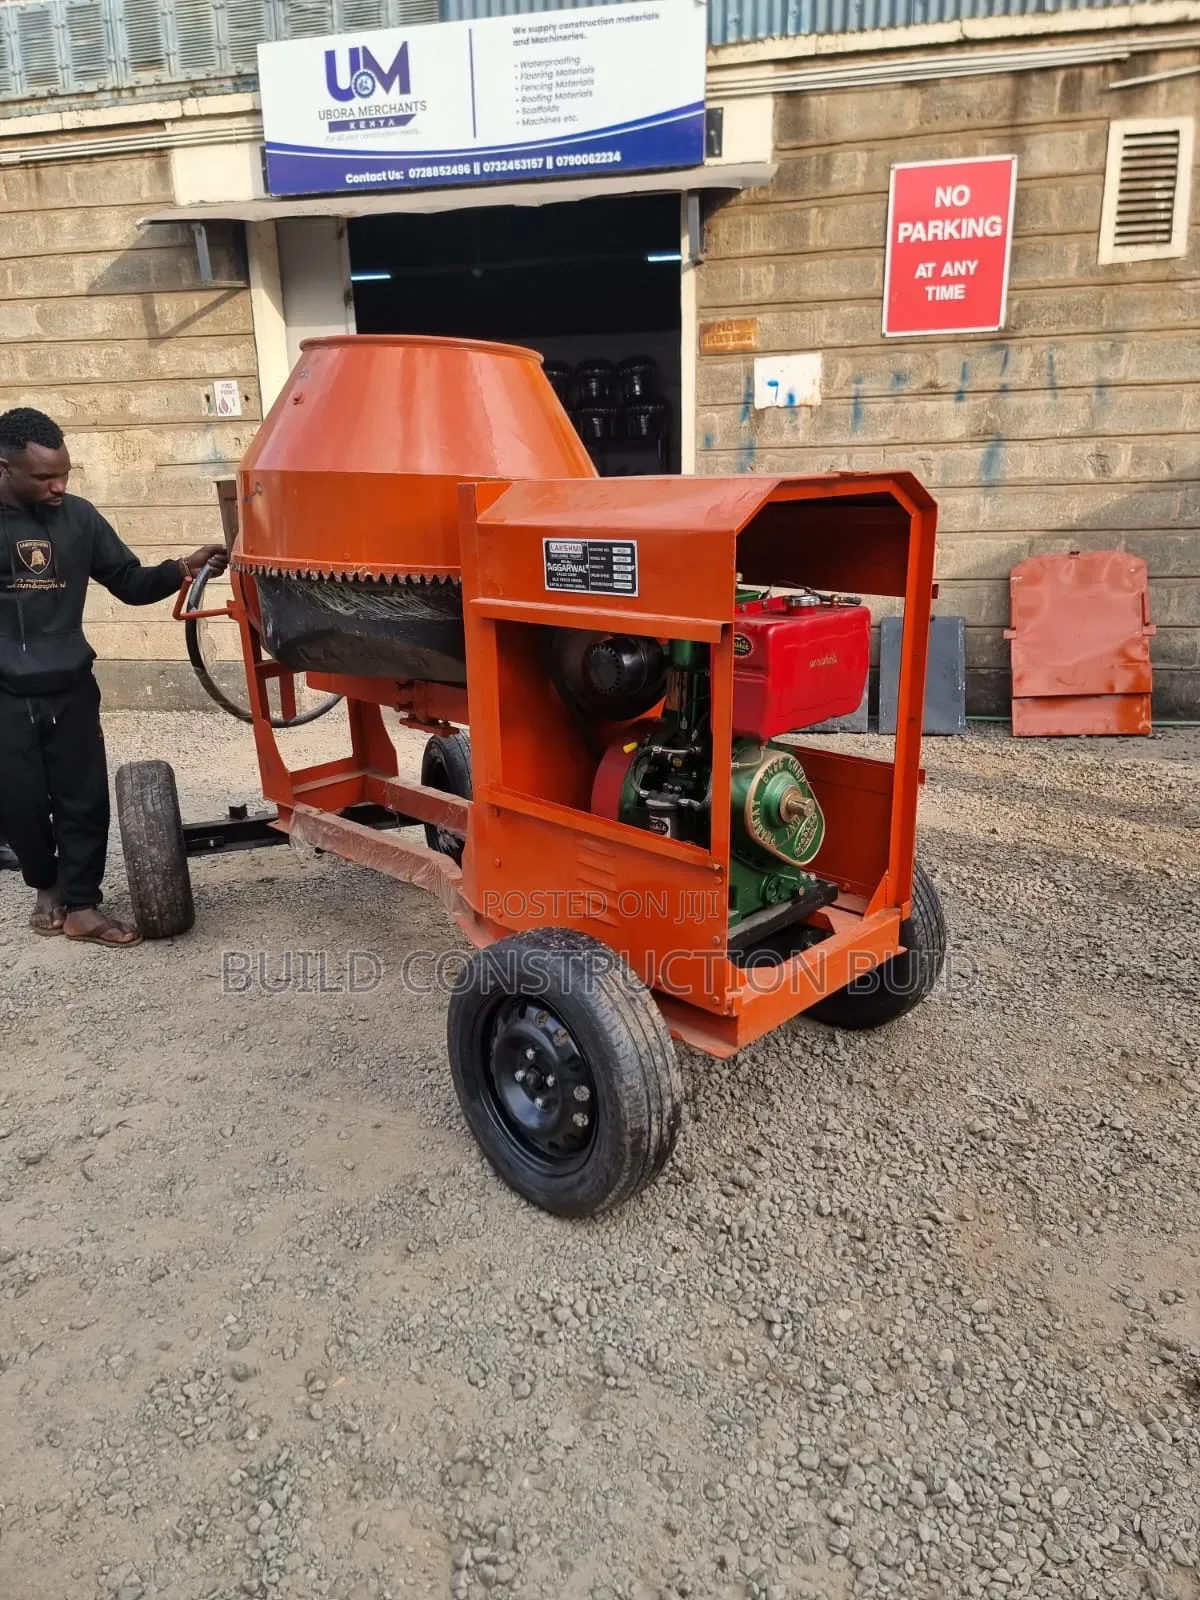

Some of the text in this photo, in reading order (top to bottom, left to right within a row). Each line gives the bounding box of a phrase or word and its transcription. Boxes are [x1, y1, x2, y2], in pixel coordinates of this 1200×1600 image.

[512, 12, 660, 35] We supply construction materials
[512, 37, 530, 46] and
[520, 65, 595, 81] Flooring Materials
[520, 77, 595, 92] Fencing Materials
[554, 89, 593, 100] Materials
[318, 100, 428, 121] UBORA MERCHANTS
[349, 119, 396, 130] KENYA
[521, 116, 562, 126] Machines
[345, 172, 387, 184] Contact
[387, 170, 405, 181] Us:
[934, 184, 971, 209] NO
[897, 215, 1003, 244] PARKING
[914, 259, 980, 280] AT ANY
[924, 284, 966, 302] TIME
